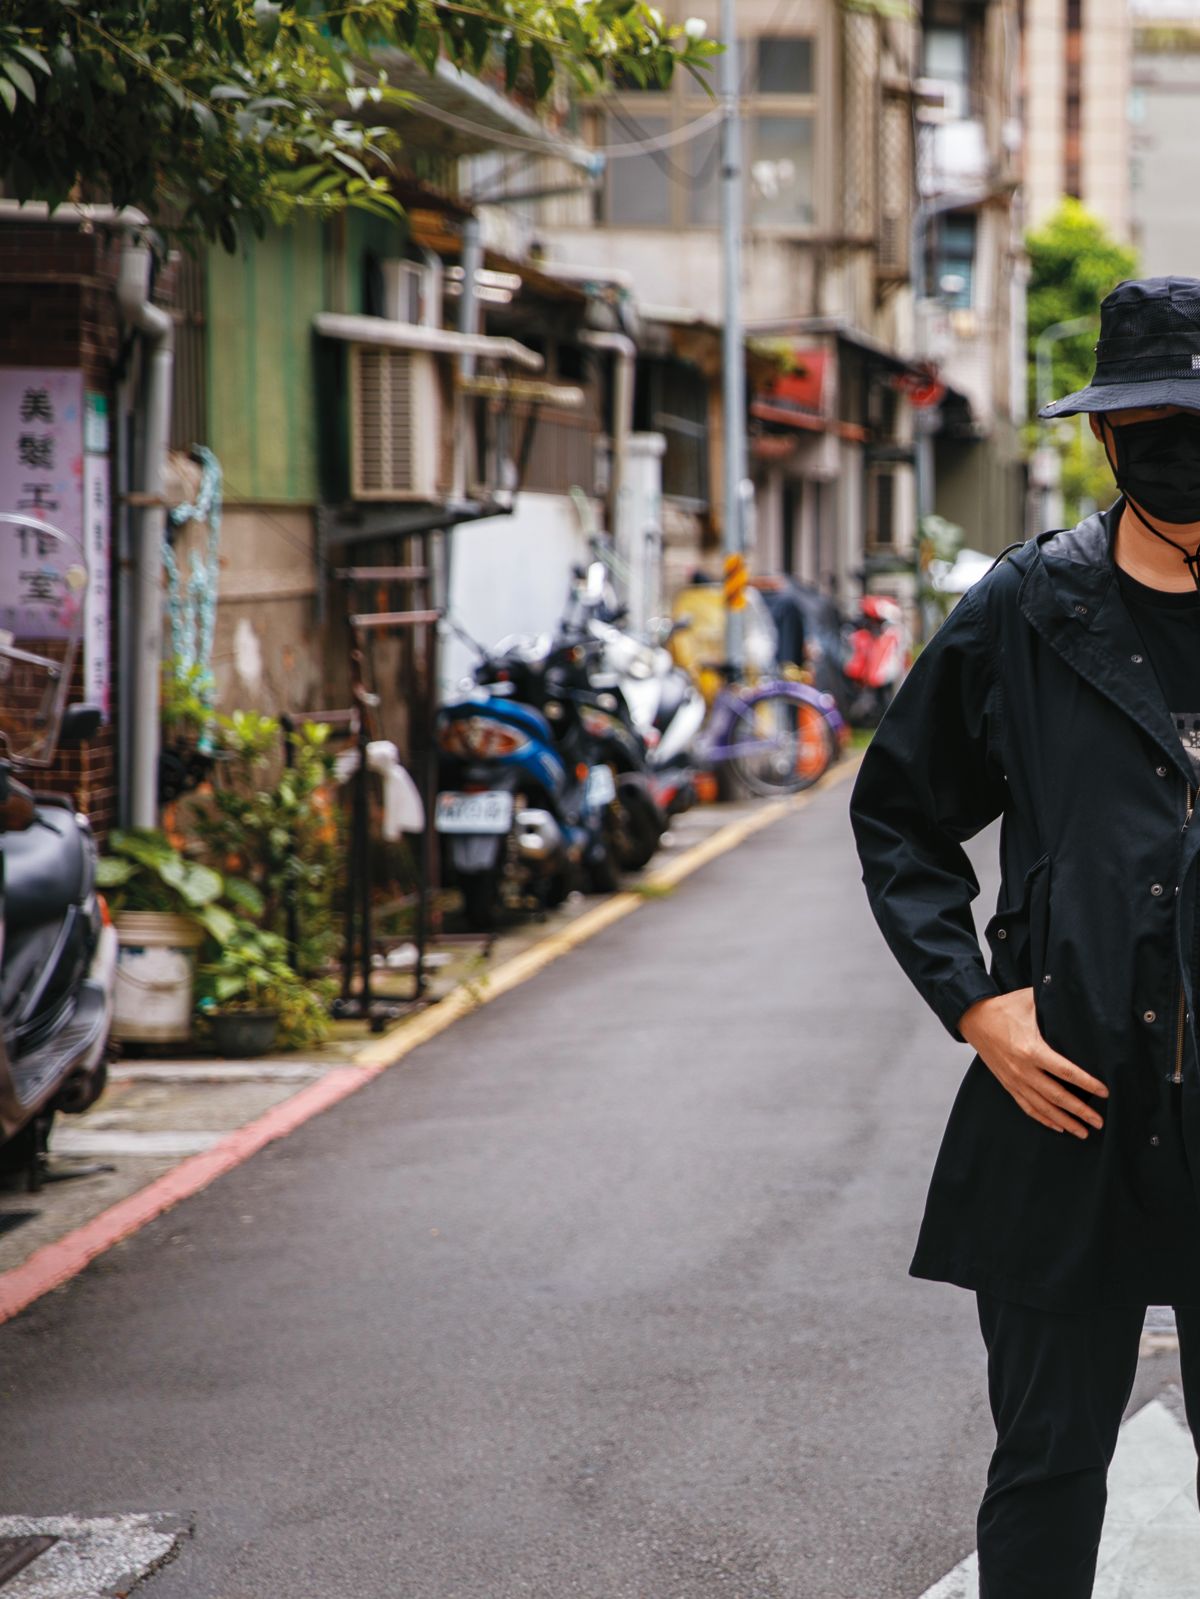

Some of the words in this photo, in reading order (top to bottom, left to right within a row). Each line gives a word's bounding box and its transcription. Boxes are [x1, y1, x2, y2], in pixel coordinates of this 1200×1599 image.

[18, 387, 60, 604] 美髮工作室
